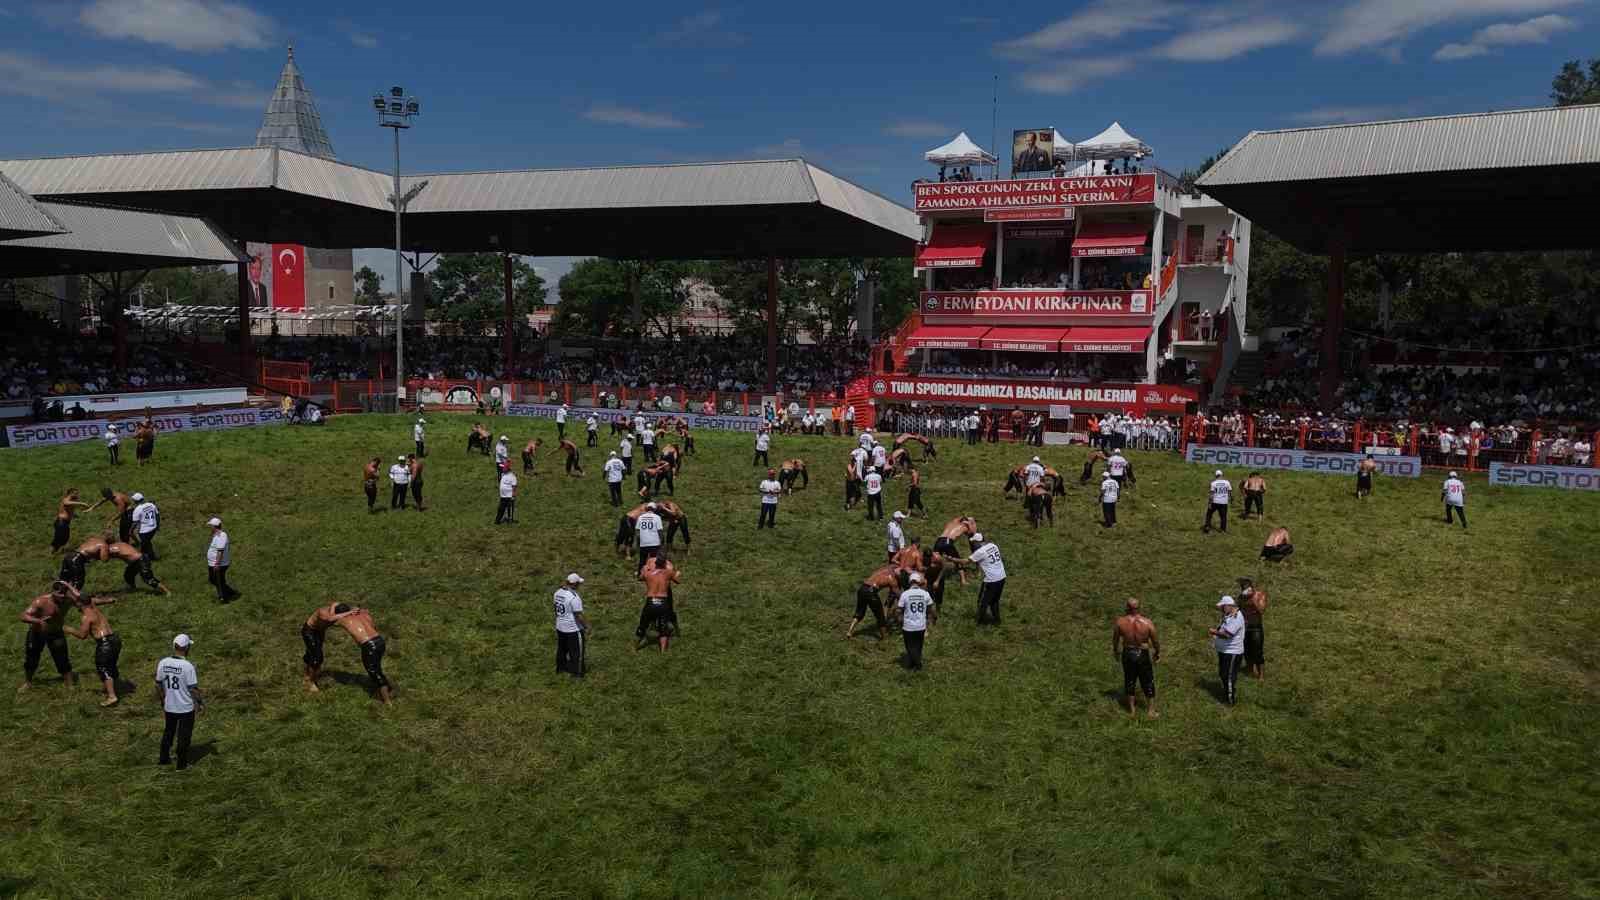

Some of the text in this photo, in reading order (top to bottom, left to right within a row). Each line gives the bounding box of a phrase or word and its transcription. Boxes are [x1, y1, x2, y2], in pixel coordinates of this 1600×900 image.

[918, 186, 940, 196] BEN
[944, 183, 1022, 195] SPORCUNUN
[1101, 178, 1133, 188] AYNI
[918, 198, 977, 208] ZAMANDA
[979, 194, 1056, 206] AHLAKLISINI
[943, 296, 1031, 310] ERMEYDANI
[1034, 296, 1122, 310] KIRKPINAR
[916, 382, 1014, 399] SPORCULARIMIZA
[13, 424, 99, 443] SPORTOTO
[190, 412, 256, 428] SPORTOTO
[1191, 448, 1413, 474] SPORTOTO SPOROTO
[641, 521, 654, 530] 80
[987, 551, 1001, 564] 35
[910, 601, 924, 613] 68
[165, 675, 179, 690] 18
